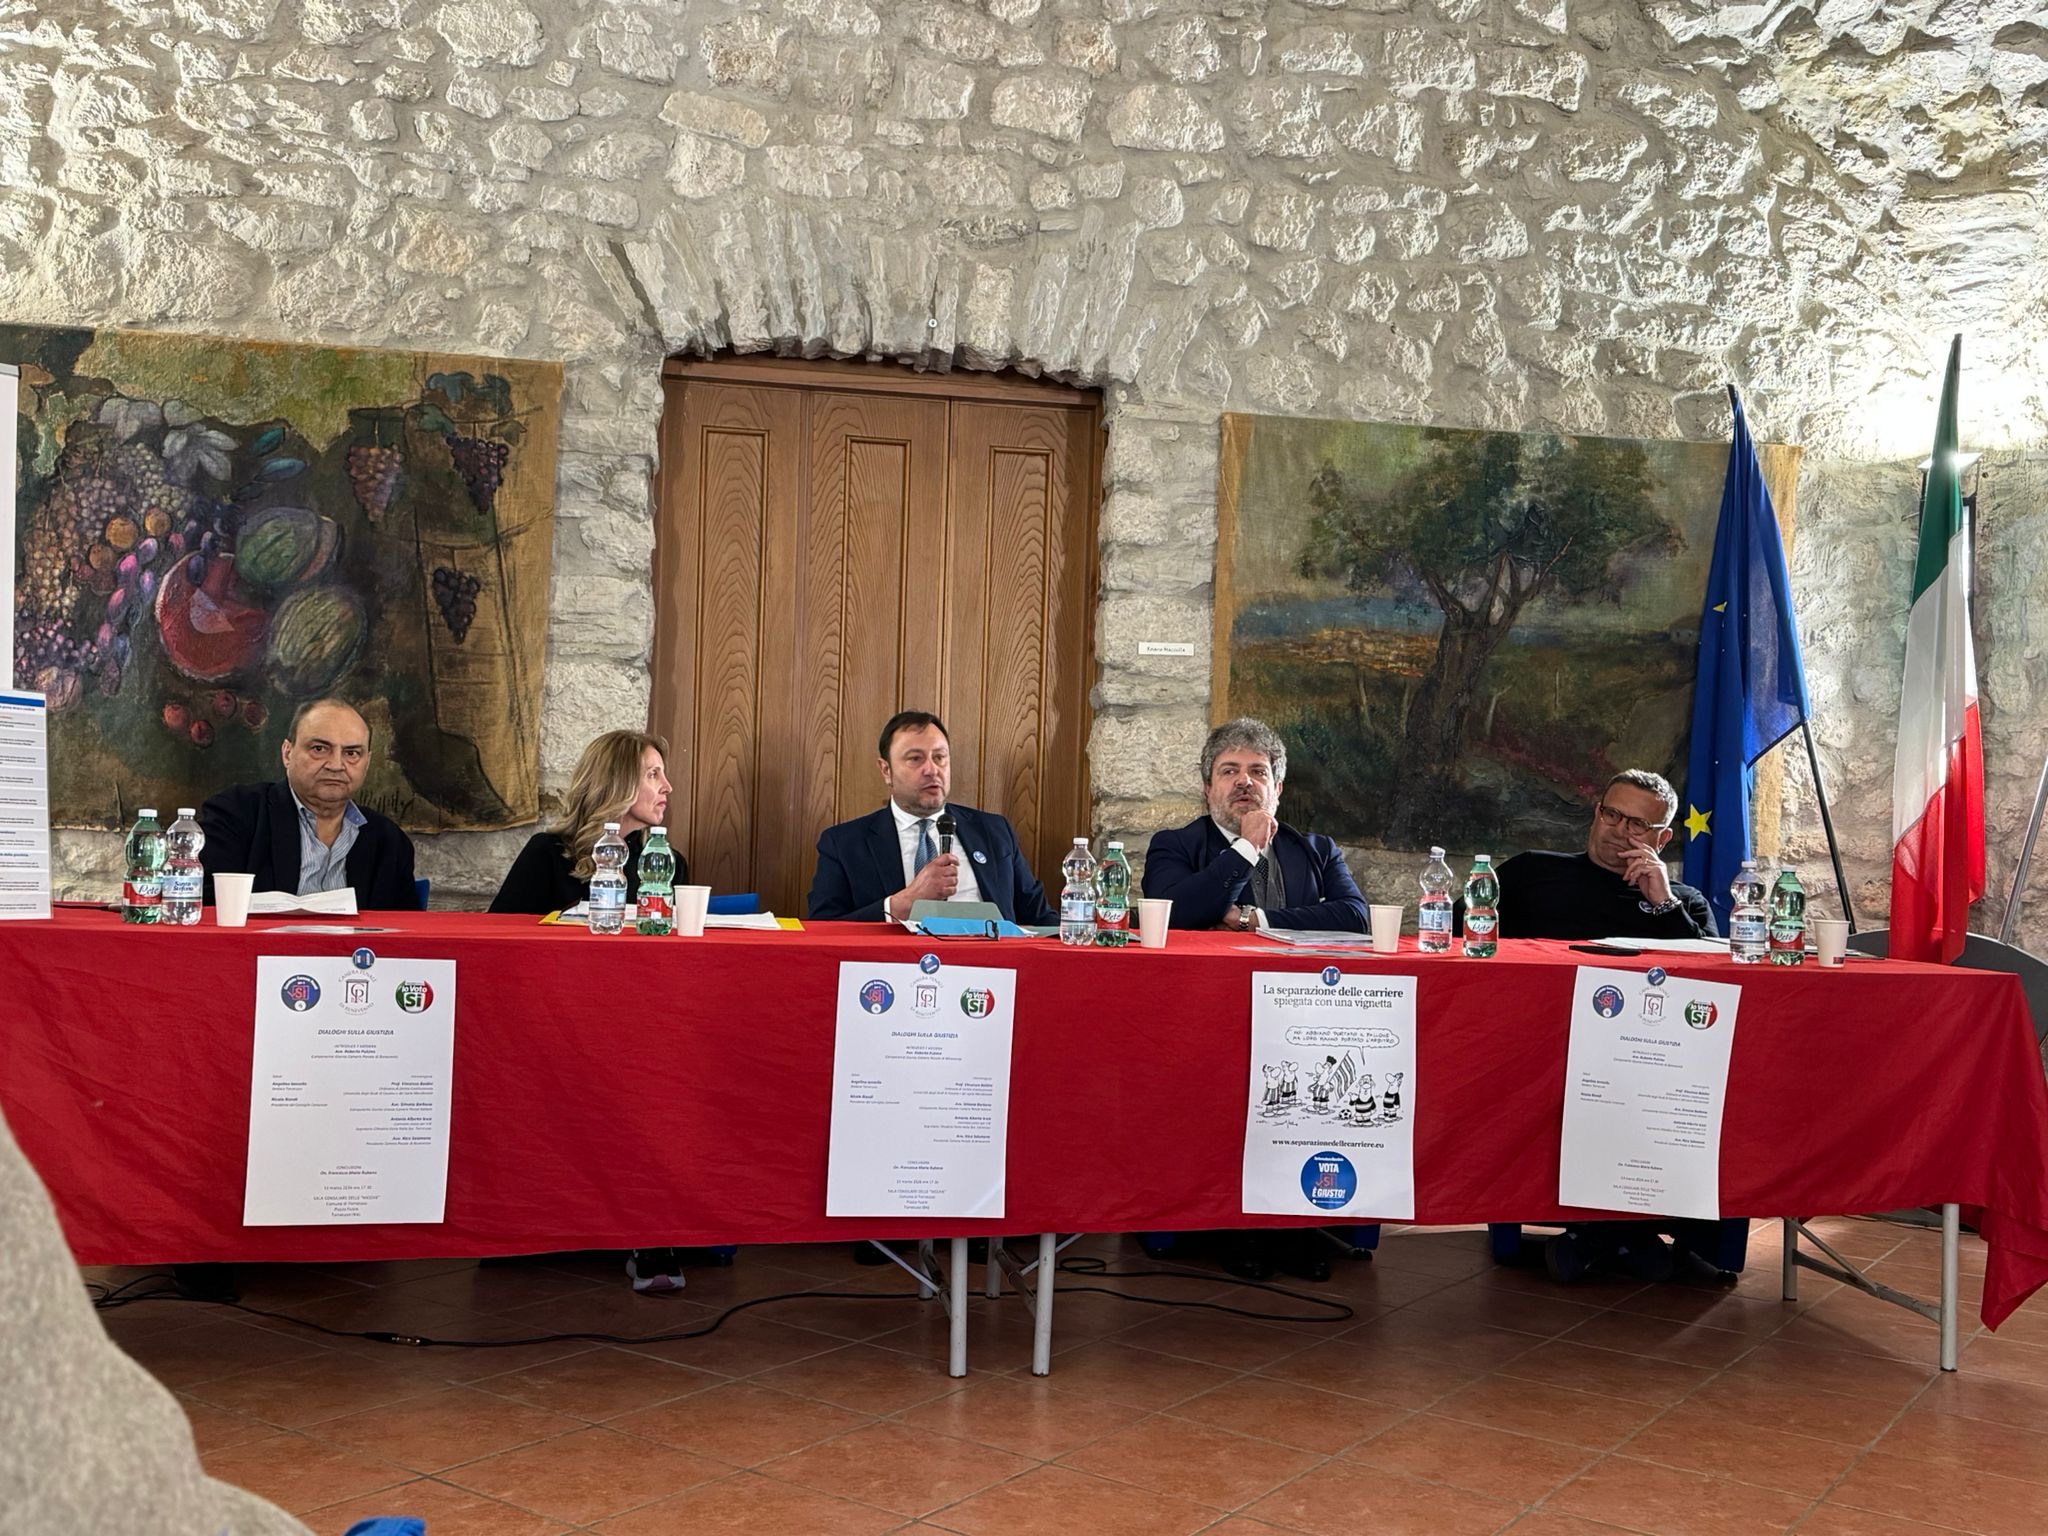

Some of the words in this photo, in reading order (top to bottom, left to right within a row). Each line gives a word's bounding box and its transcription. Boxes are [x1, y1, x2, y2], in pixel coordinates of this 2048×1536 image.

[1263, 984, 1274, 994] La
[1276, 985, 1336, 997] separazione
[1338, 986, 1362, 997] delle
[1364, 988, 1404, 998] carriere
[1274, 997, 1313, 1008] spiegata
[1315, 998, 1332, 1006] con
[1335, 999, 1352, 1007] una
[1354, 999, 1392, 1009] vignetta
[1272, 1140, 1384, 1148] www.separazionedellecarriere.eu
[1319, 1163, 1339, 1173] VOTA
[1317, 1189, 1346, 1198] GIUSTO!
